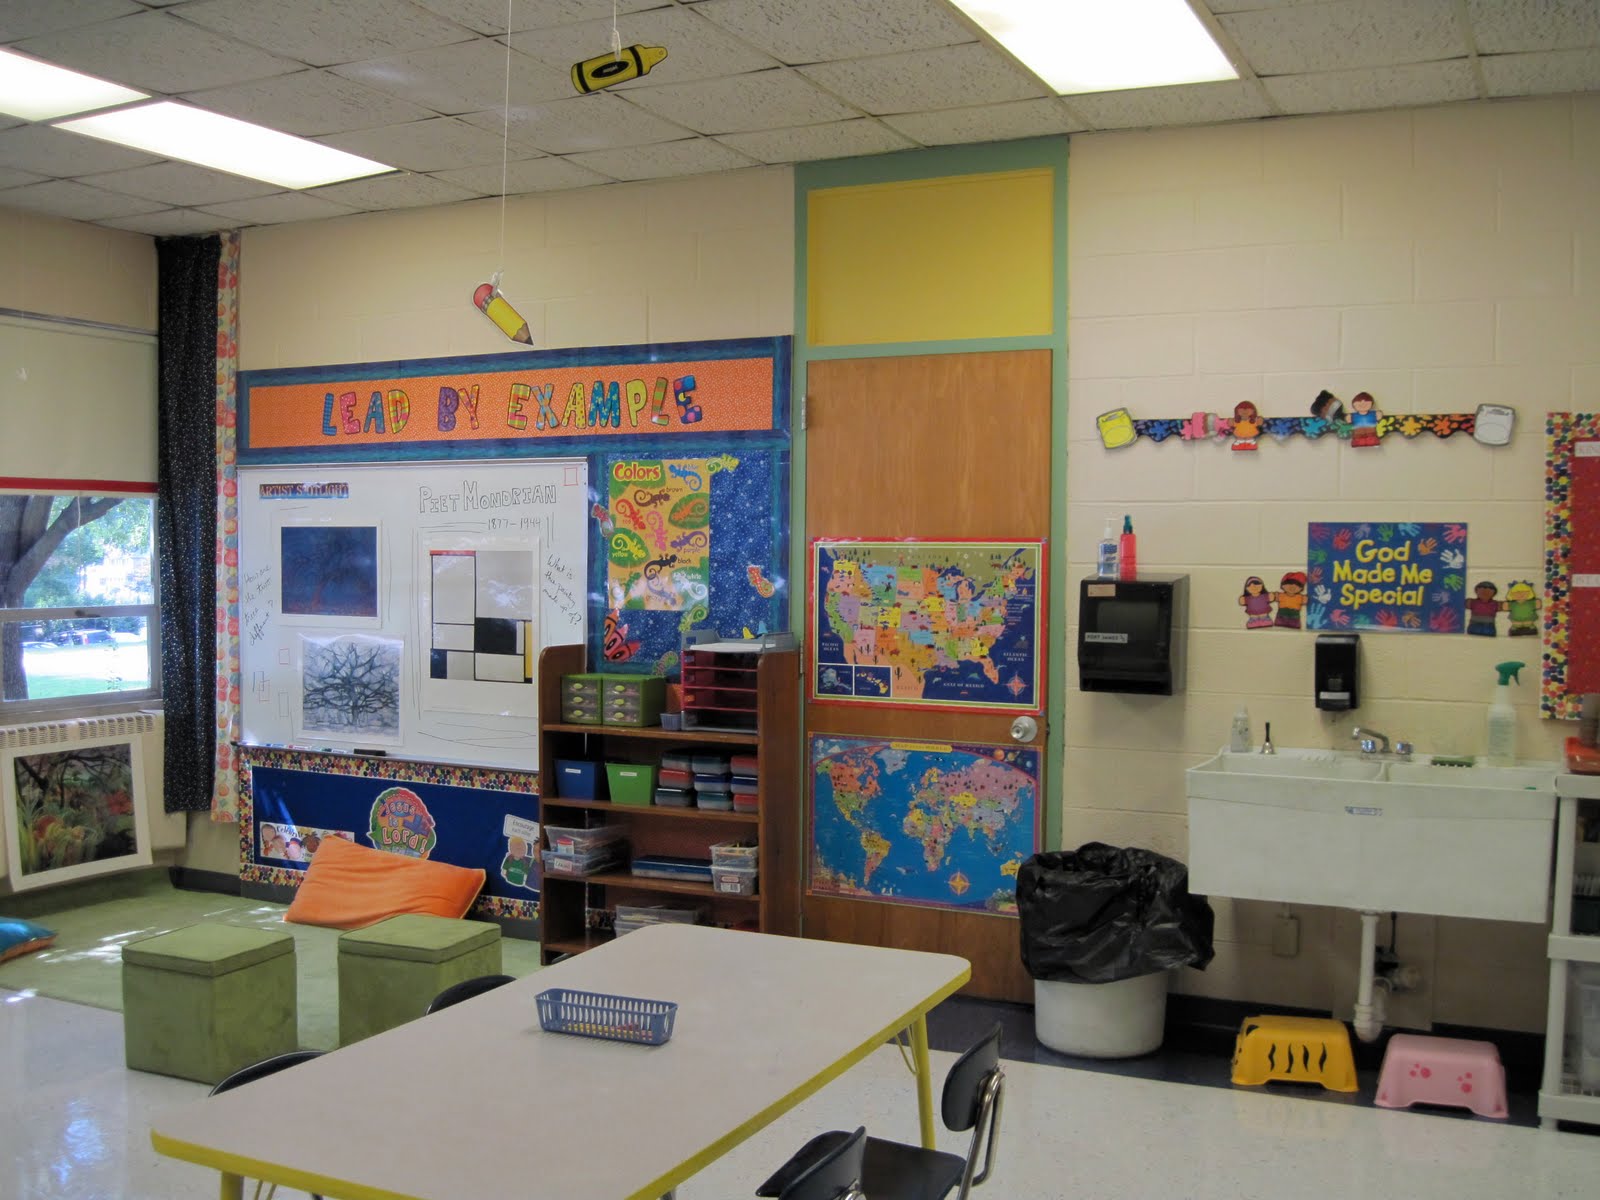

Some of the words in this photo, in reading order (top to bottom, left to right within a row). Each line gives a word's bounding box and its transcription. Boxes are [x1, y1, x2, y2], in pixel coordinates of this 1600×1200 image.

[322, 388, 410, 436] LEAD
[437, 384, 480, 432] BY
[507, 375, 703, 431] EXAMPLE
[613, 462, 661, 482] Colors
[260, 484, 294, 497] ARTIST
[1356, 539, 1411, 563] God
[1333, 560, 1396, 584] Made
[1400, 563, 1433, 585] Me
[1340, 583, 1425, 610] Special
[383, 802, 416, 816] Jesus
[389, 816, 398, 828] is
[382, 827, 428, 854] Lord!
